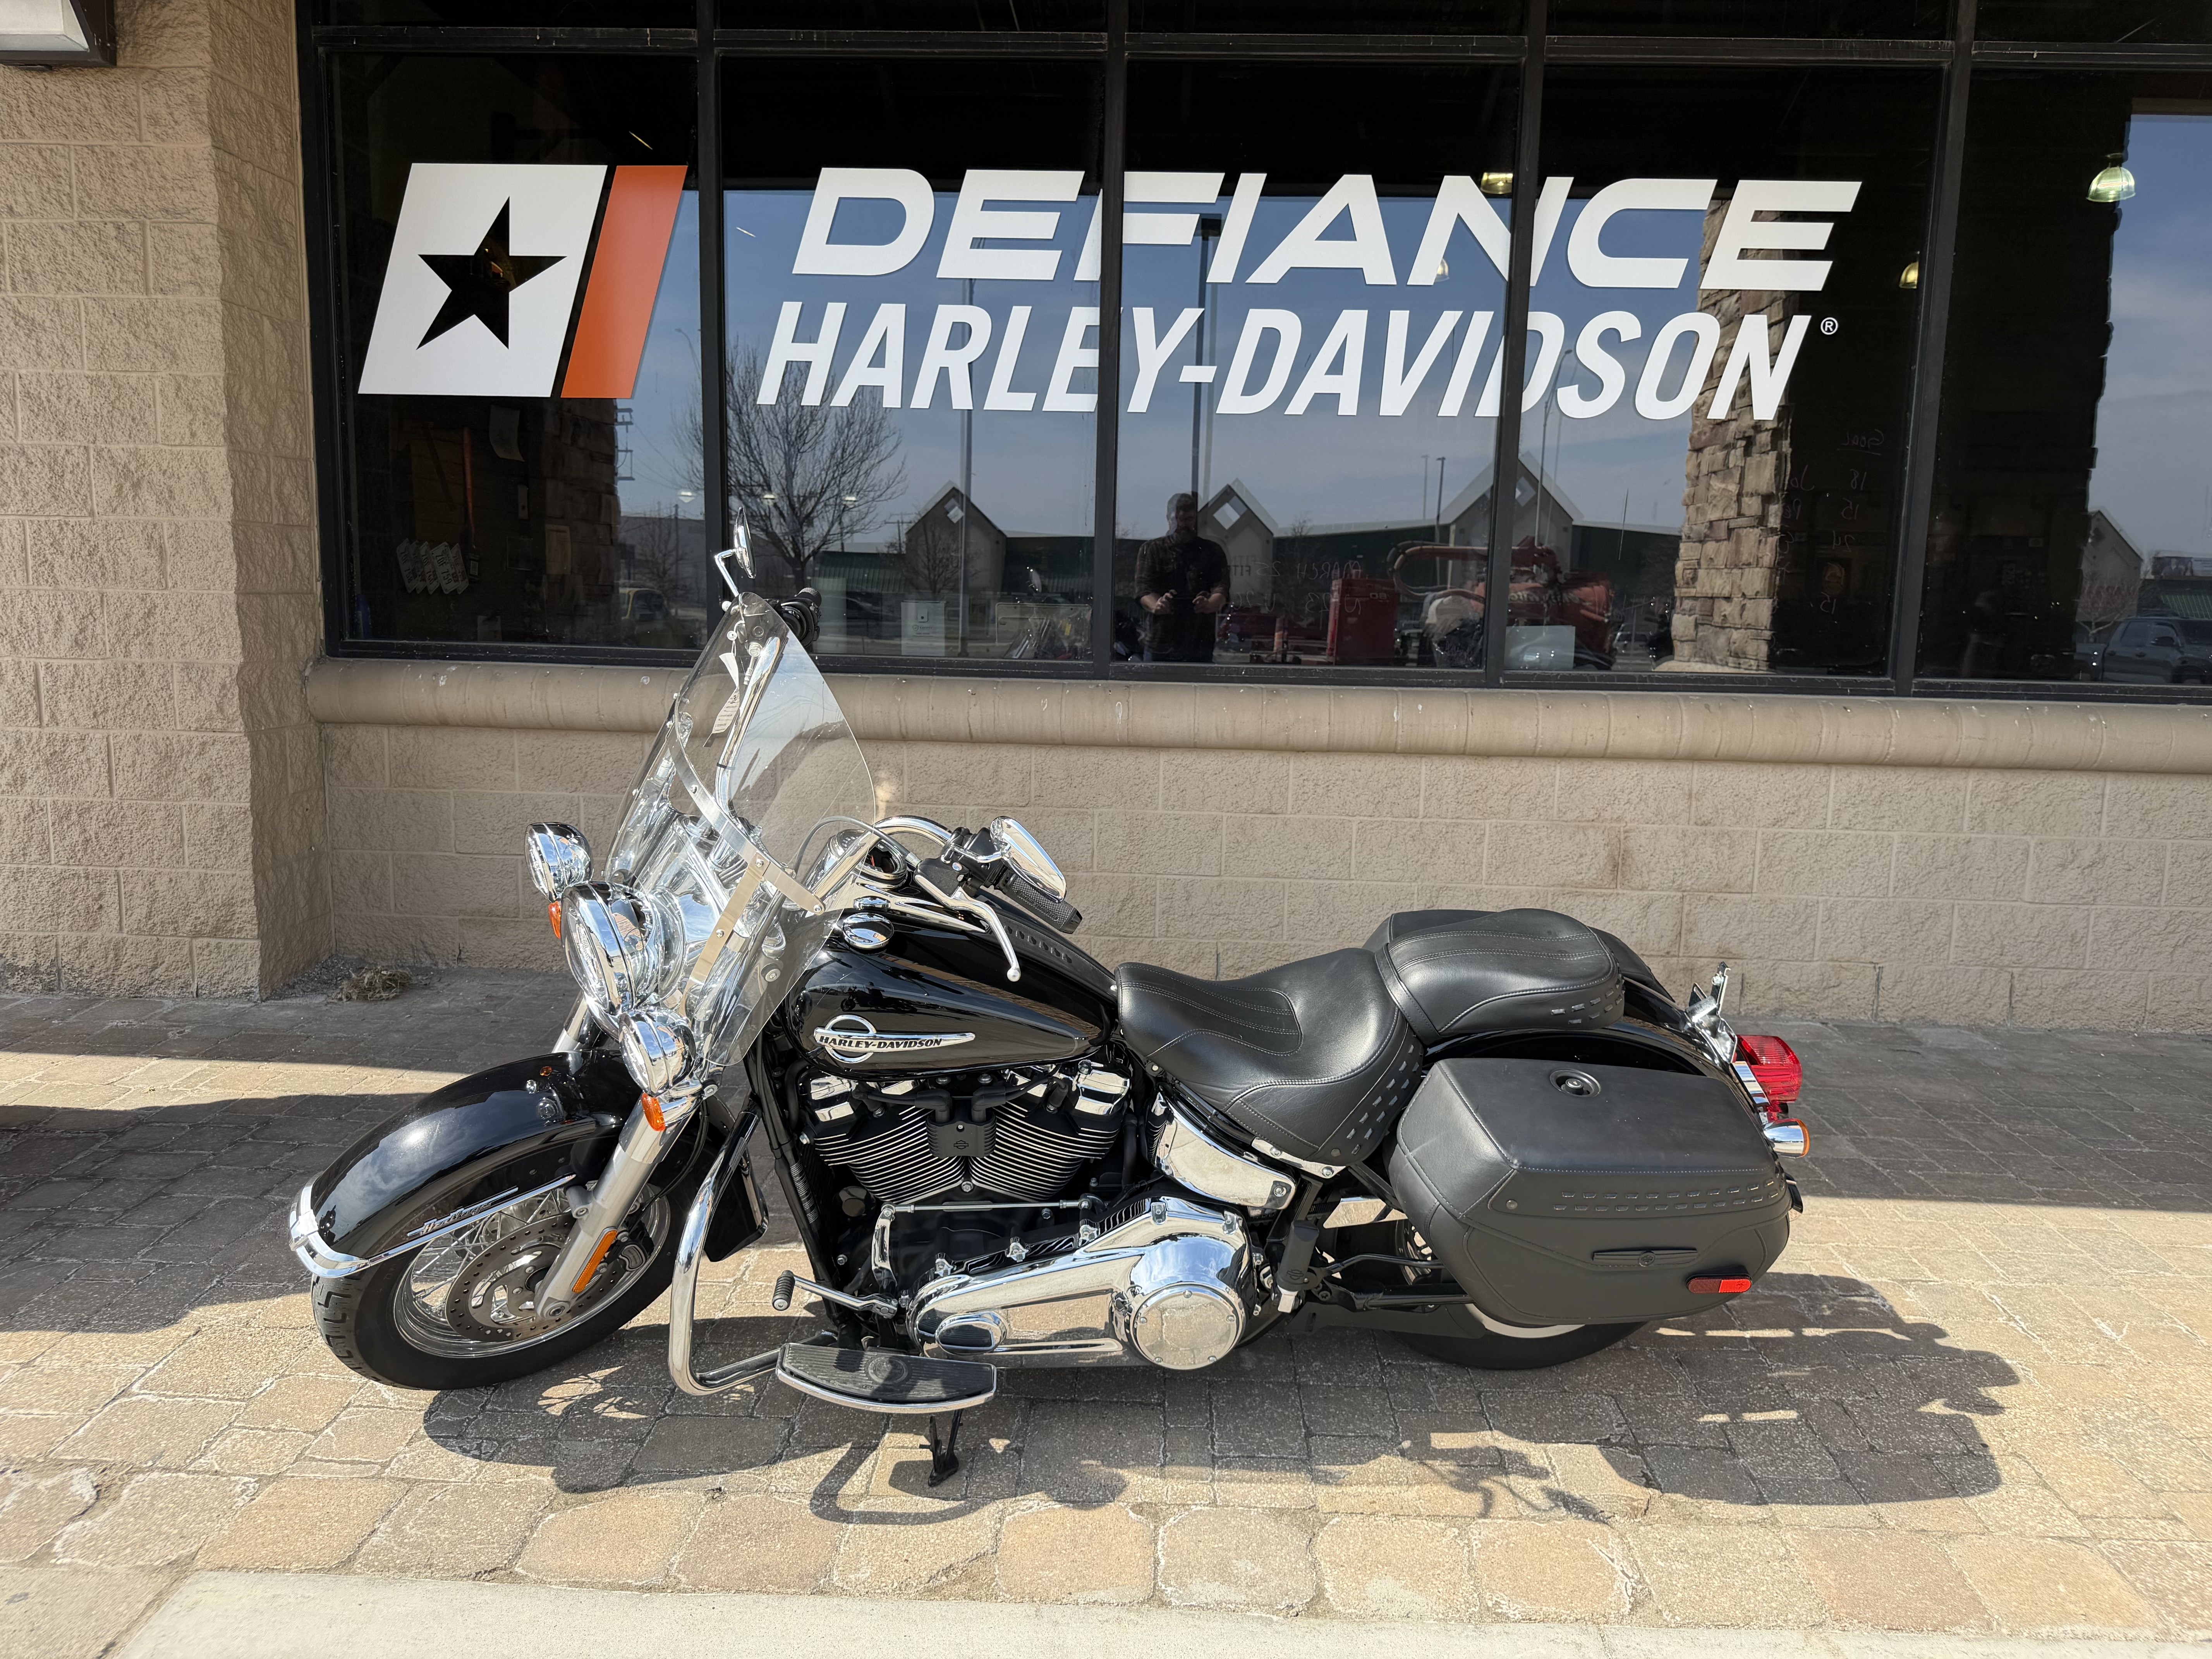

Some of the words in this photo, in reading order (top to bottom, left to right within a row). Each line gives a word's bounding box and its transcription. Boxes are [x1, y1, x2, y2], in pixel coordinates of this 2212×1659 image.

[793, 167, 1863, 292] DEFIANCE
[756, 301, 1811, 420] HARLEY-DAVIDSON
[819, 1034, 942, 1049] HARLEY-DAVIDSON
